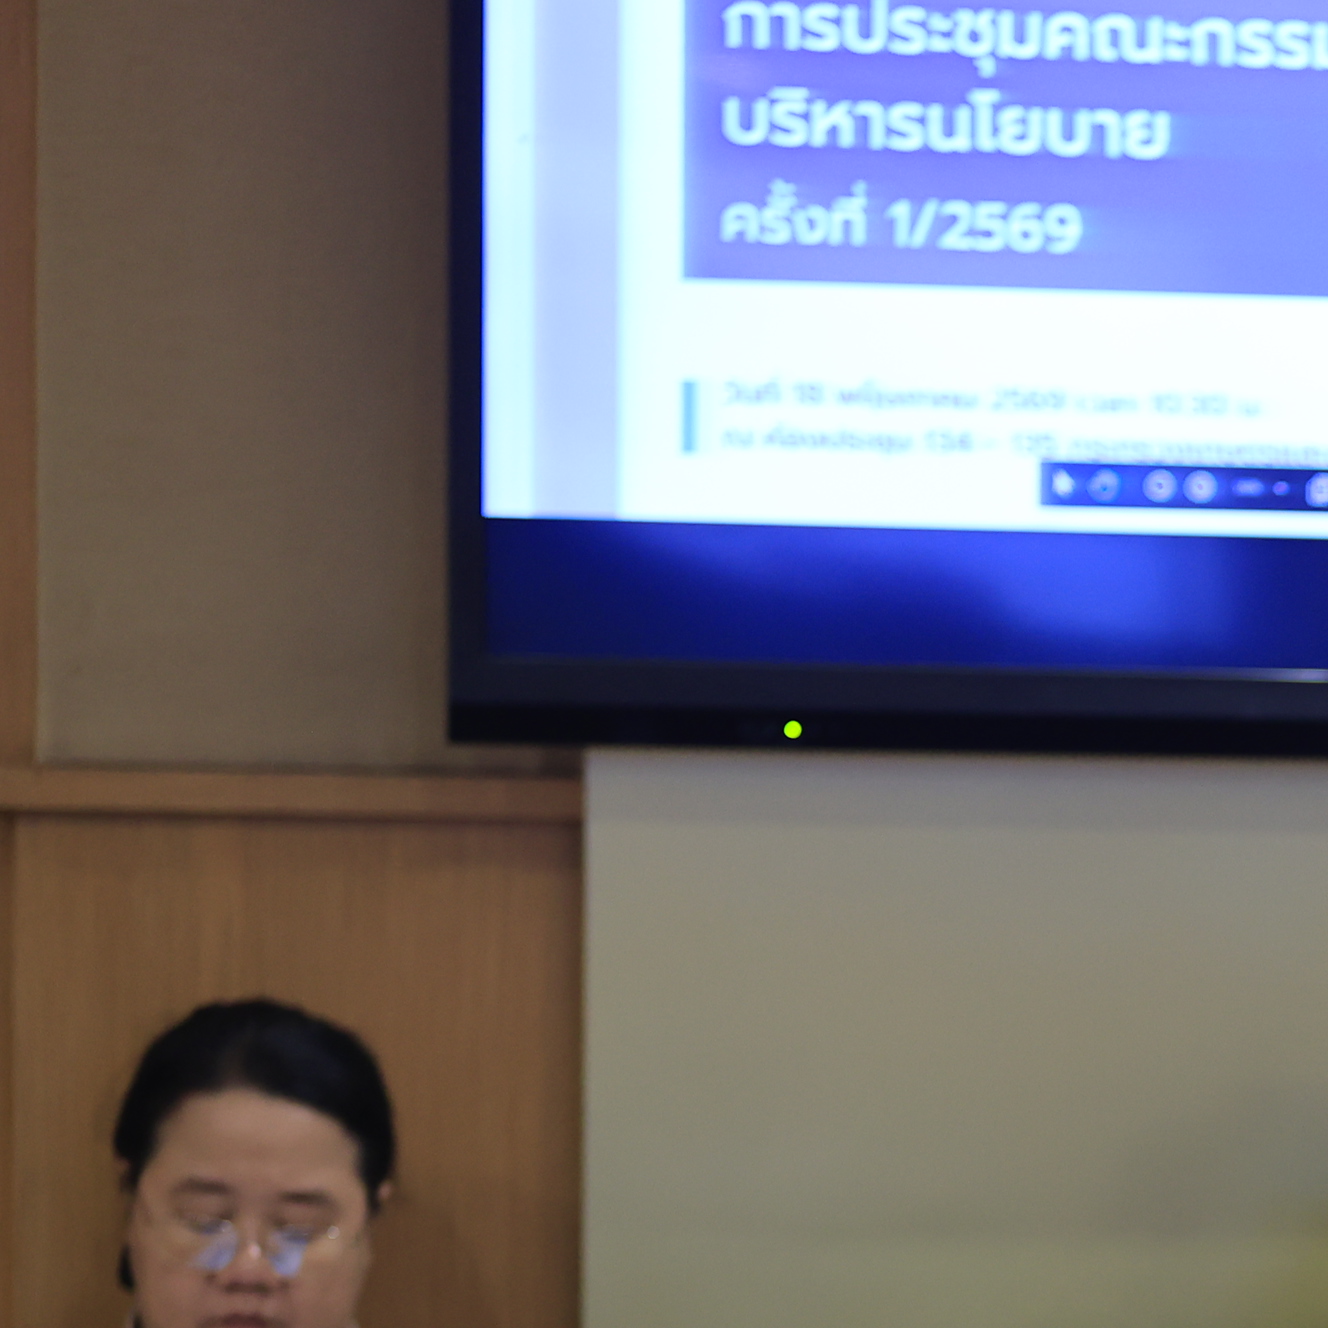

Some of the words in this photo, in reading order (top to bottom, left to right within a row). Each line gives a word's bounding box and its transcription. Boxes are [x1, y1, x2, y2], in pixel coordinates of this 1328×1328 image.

[721, 86, 1171, 160] บริหารนโยบาย
[719, 178, 868, 246] ครั้งที่
[885, 198, 1084, 254] 1/2569
